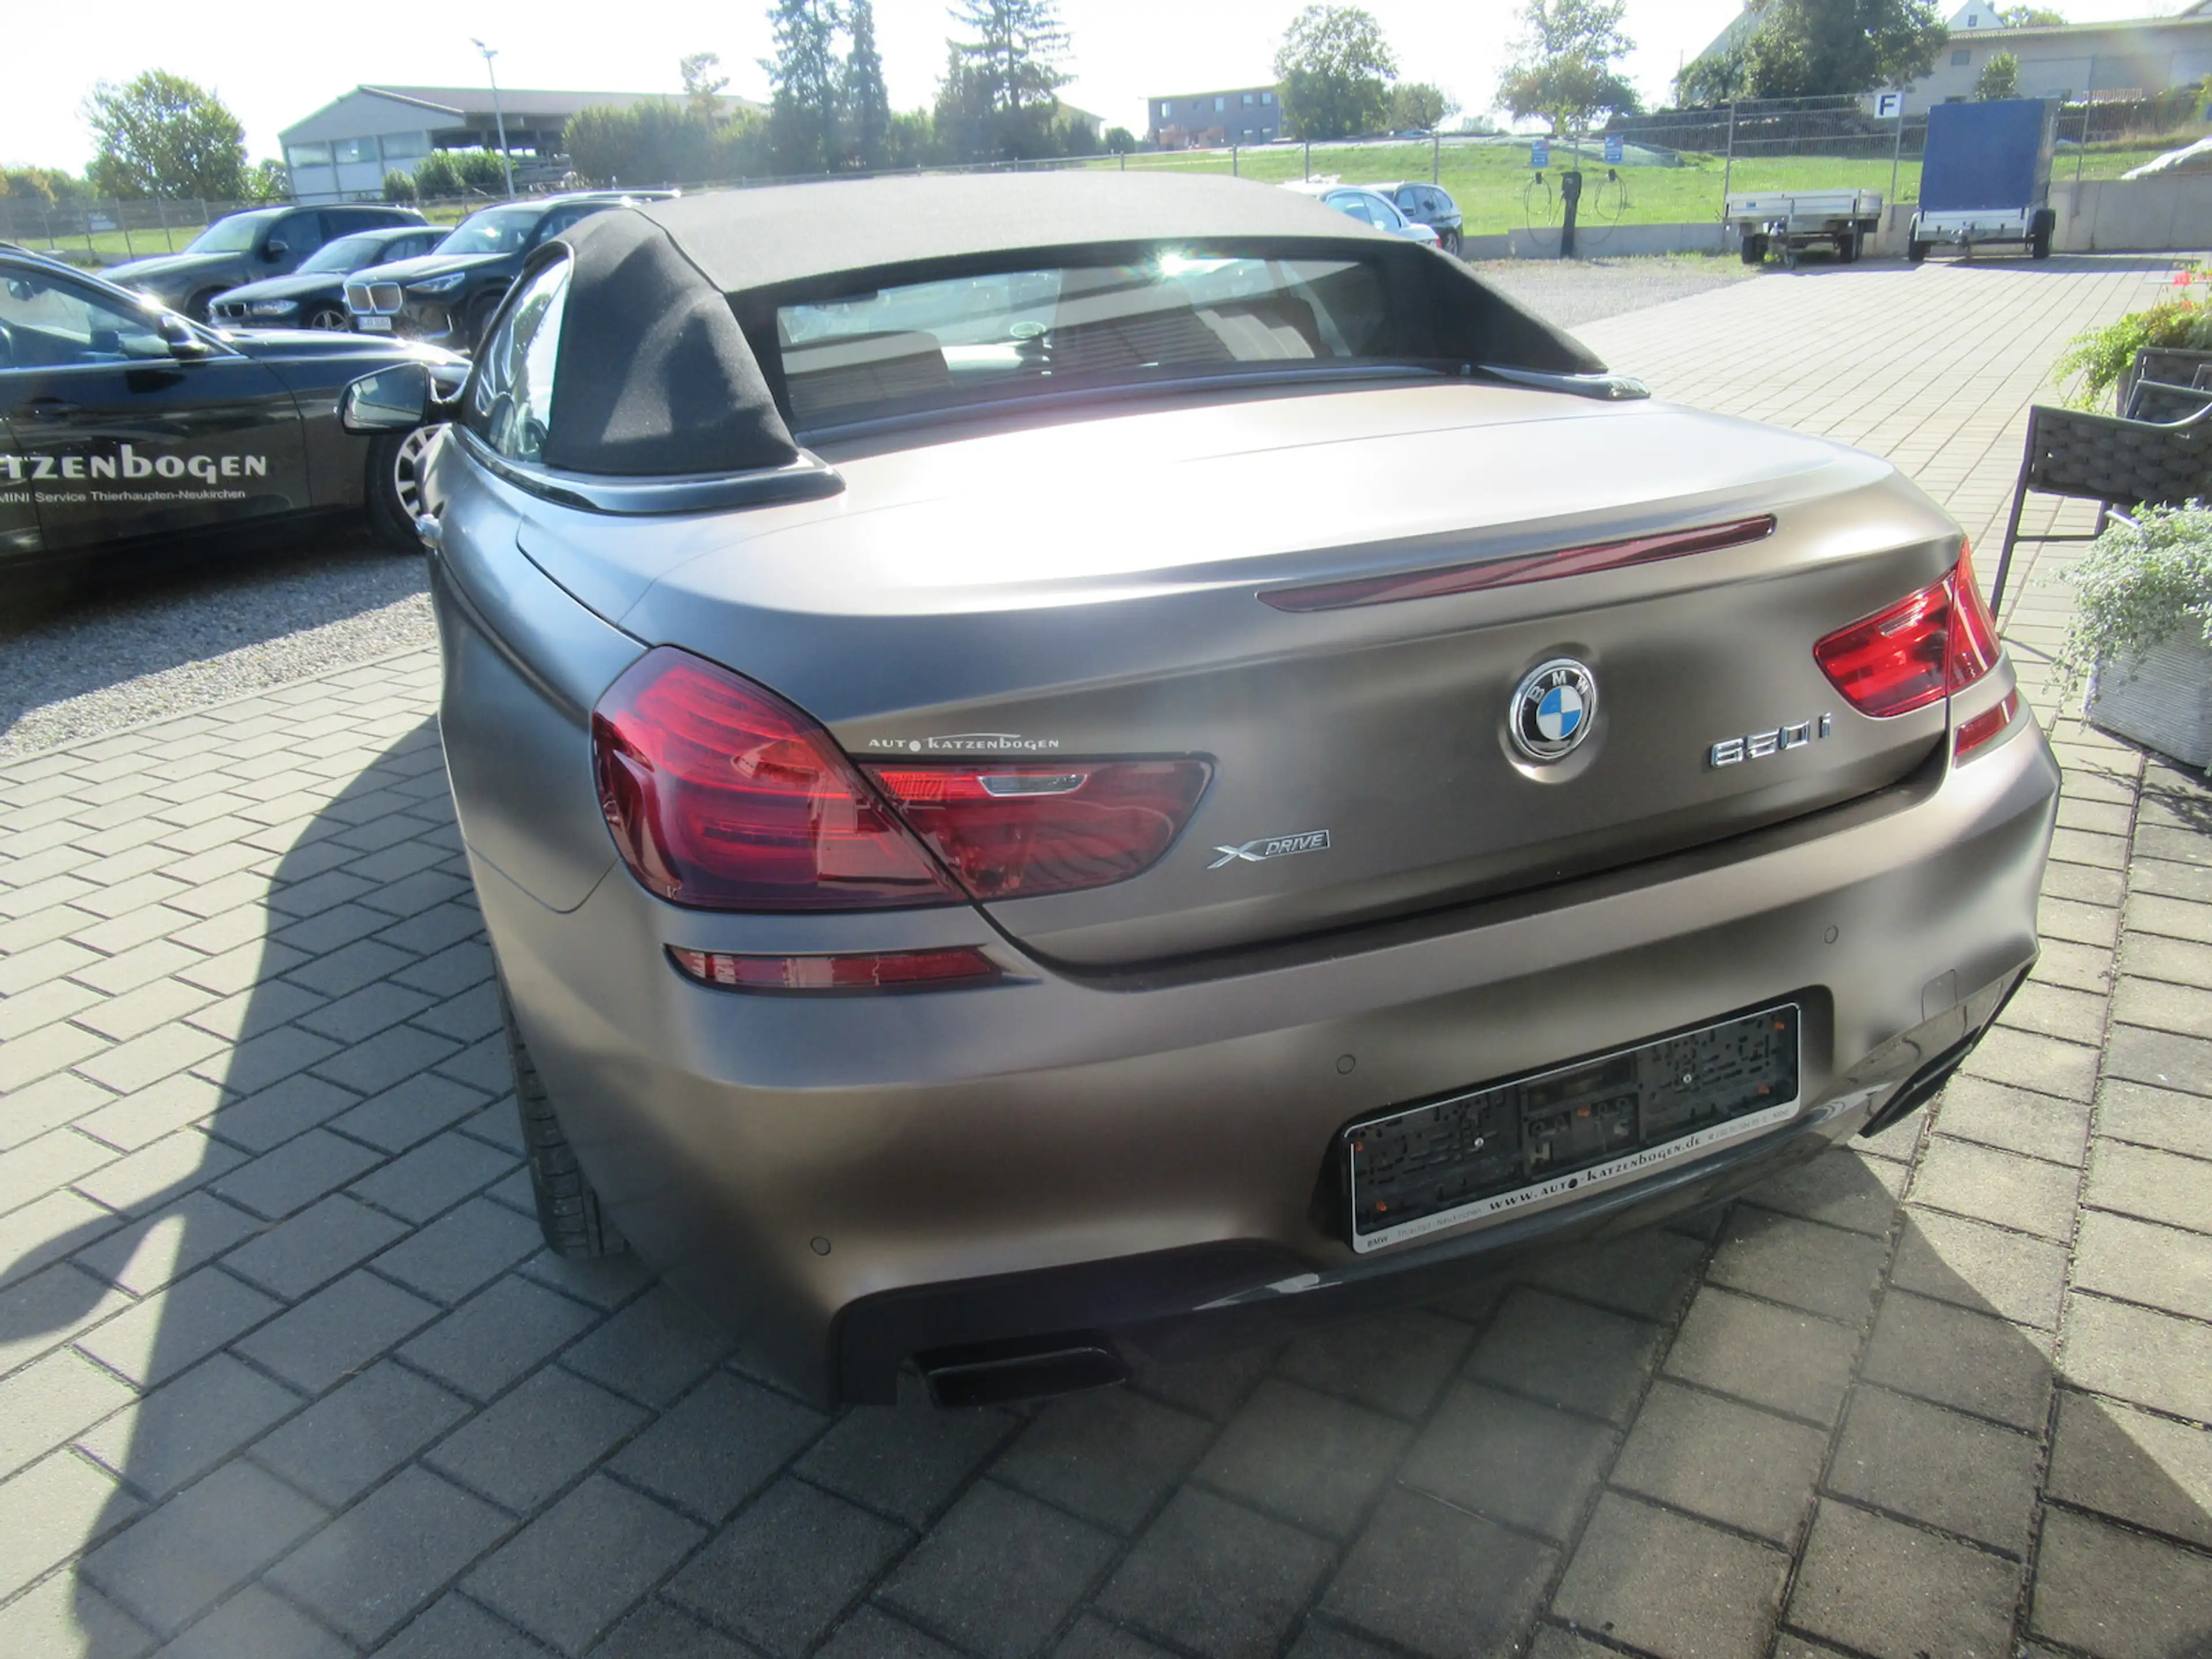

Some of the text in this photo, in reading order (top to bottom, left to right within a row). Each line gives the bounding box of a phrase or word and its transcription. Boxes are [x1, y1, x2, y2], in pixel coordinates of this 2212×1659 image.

[1879, 94, 1896, 116] F
[35, 491, 86, 503] Service
[90, 490, 246, 502] Thierhaupten-Neukirchen
[1528, 670, 1589, 704] BMW
